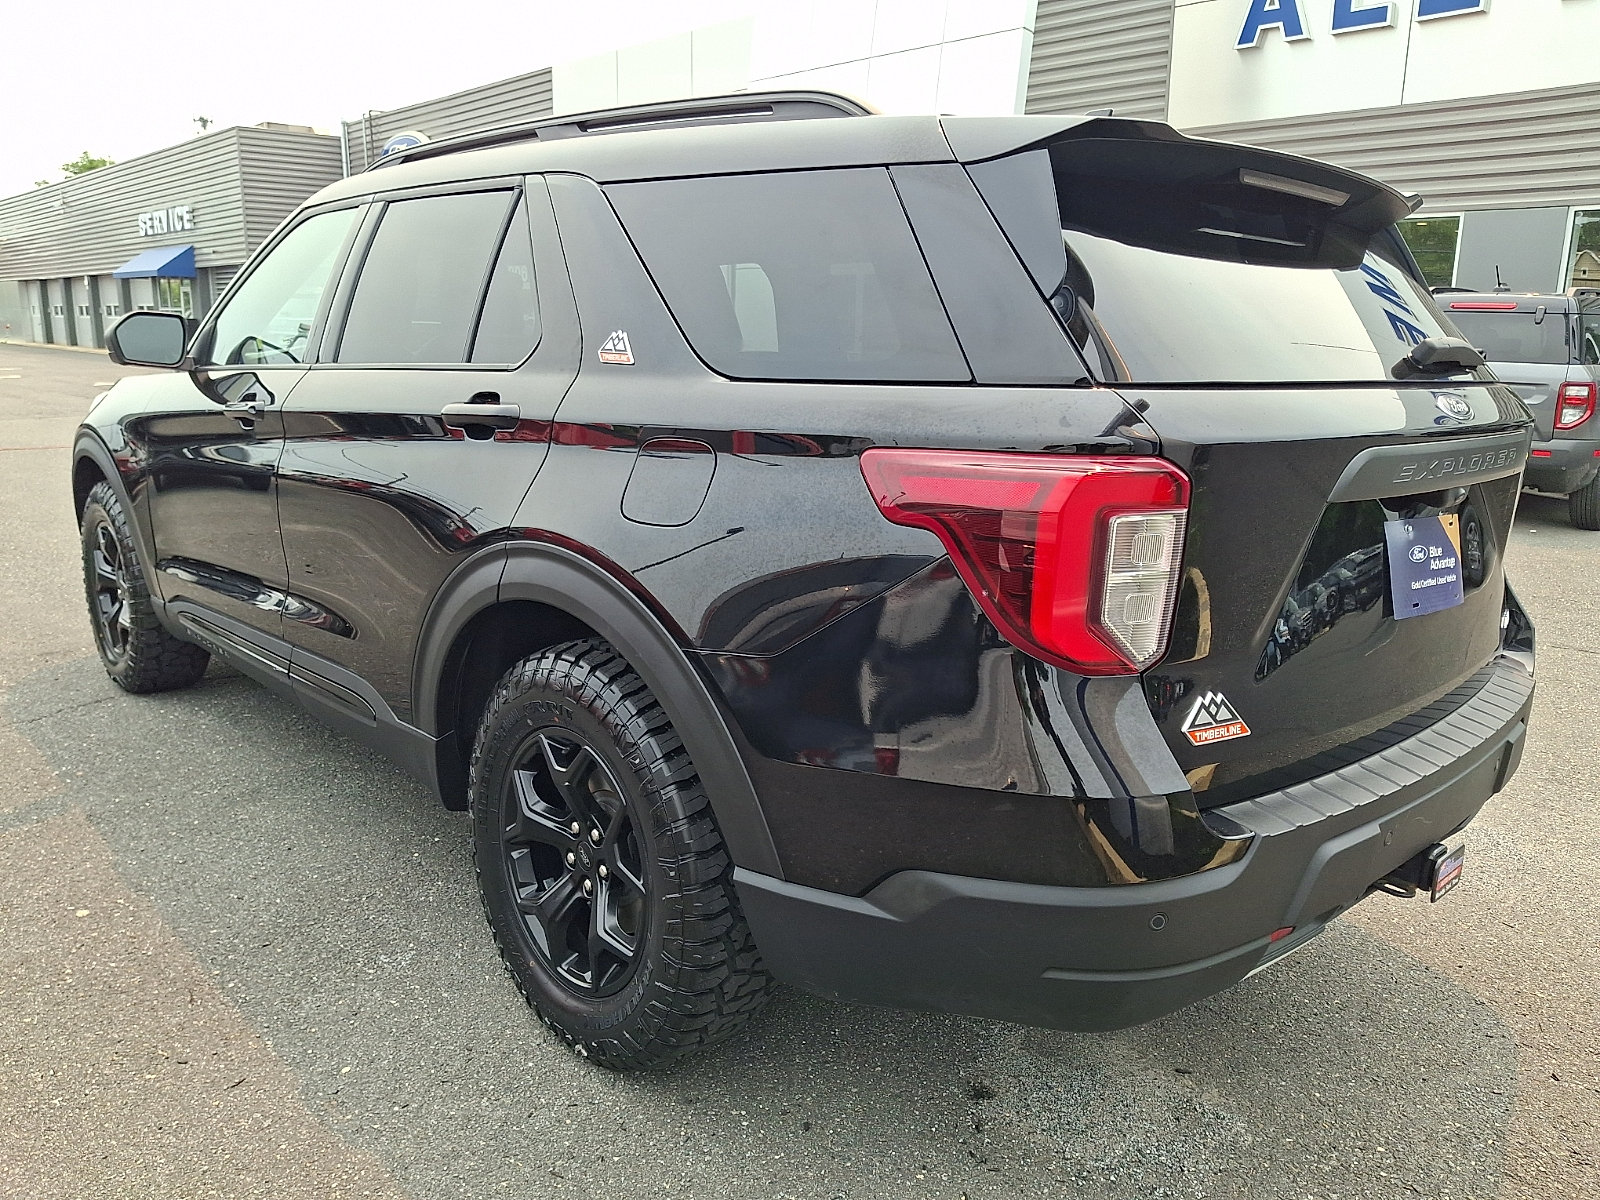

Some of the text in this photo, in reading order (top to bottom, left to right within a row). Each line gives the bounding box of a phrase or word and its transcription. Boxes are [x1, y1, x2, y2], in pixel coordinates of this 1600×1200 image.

[138, 205, 193, 237] SERVICE
[1393, 447, 1517, 483] EXPLORER
[1429, 546, 1443, 558] Blue
[1430, 557, 1456, 570] Advantage
[1411, 580, 1421, 590] Gold
[1421, 577, 1437, 588] Certified
[1437, 575, 1447, 585] Used
[1194, 724, 1242, 742] TIMBERLINE
